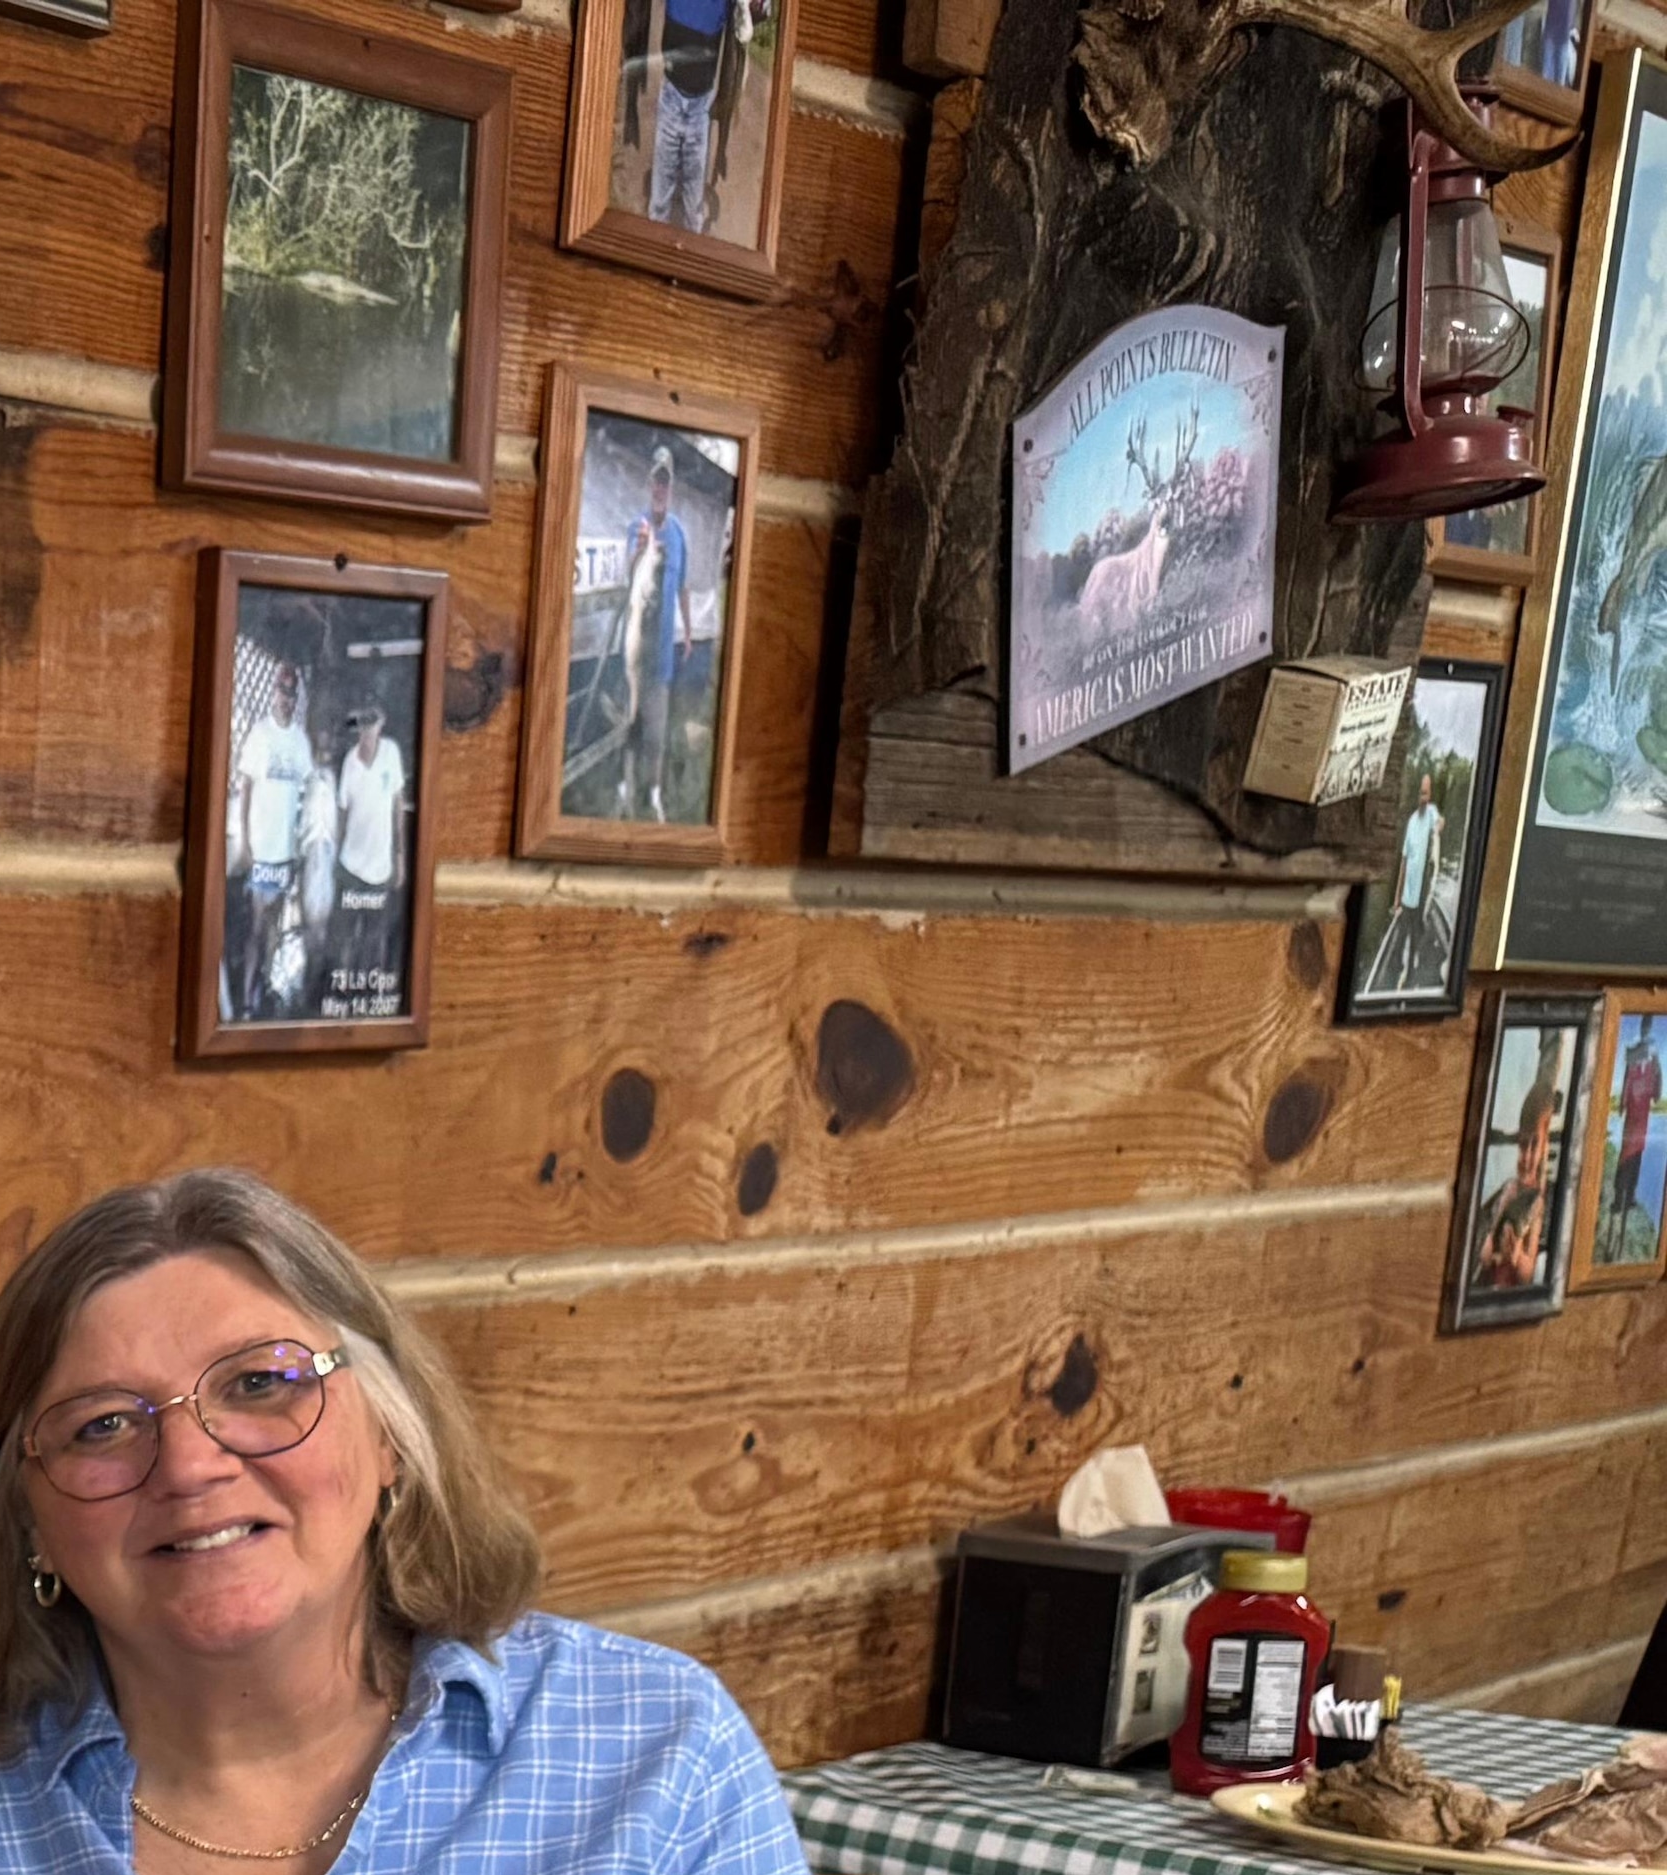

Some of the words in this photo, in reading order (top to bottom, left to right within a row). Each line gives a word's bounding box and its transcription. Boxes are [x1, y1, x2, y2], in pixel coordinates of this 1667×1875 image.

[1070, 380, 1099, 445] ALL
[1100, 336, 1158, 411] POINTS
[1159, 330, 1237, 383] BULLETIN
[1127, 640, 1179, 703] MOST
[1179, 608, 1254, 674] WANTED
[1349, 671, 1407, 703] ESTATE
[252, 863, 290, 887] Doug
